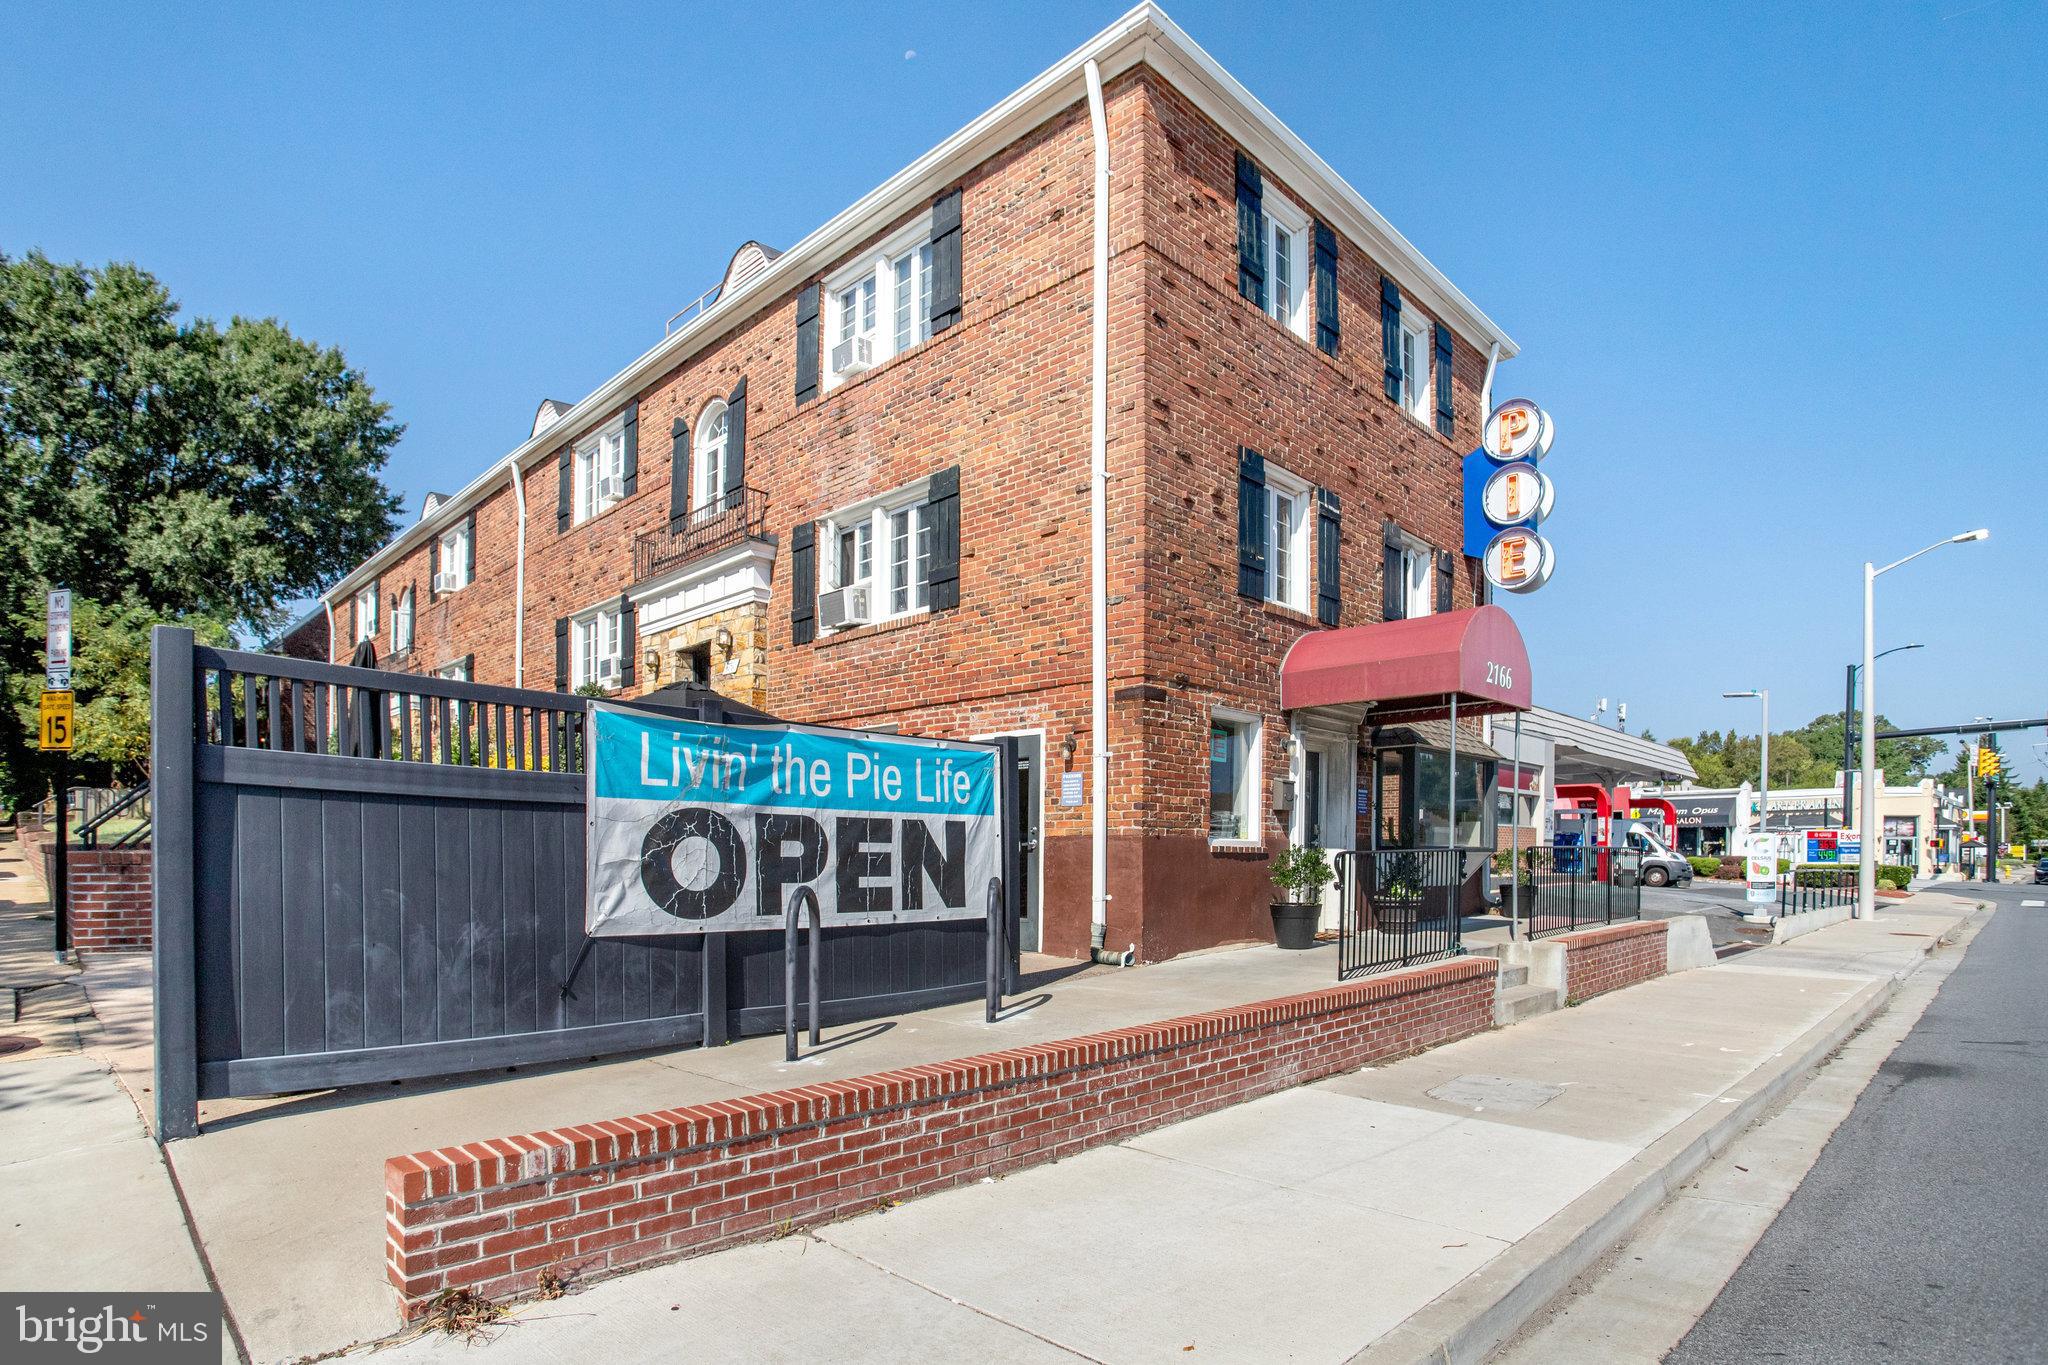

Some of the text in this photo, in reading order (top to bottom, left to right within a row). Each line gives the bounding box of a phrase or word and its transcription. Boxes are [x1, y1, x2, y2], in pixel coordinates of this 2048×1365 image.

[54, 596, 65, 608] NO
[1486, 661, 1512, 689] 2166
[47, 715, 66, 743] 15
[640, 731, 971, 804] Livin' the Pie Life
[1692, 807, 1719, 815] Opus
[640, 807, 966, 920] OPEN
